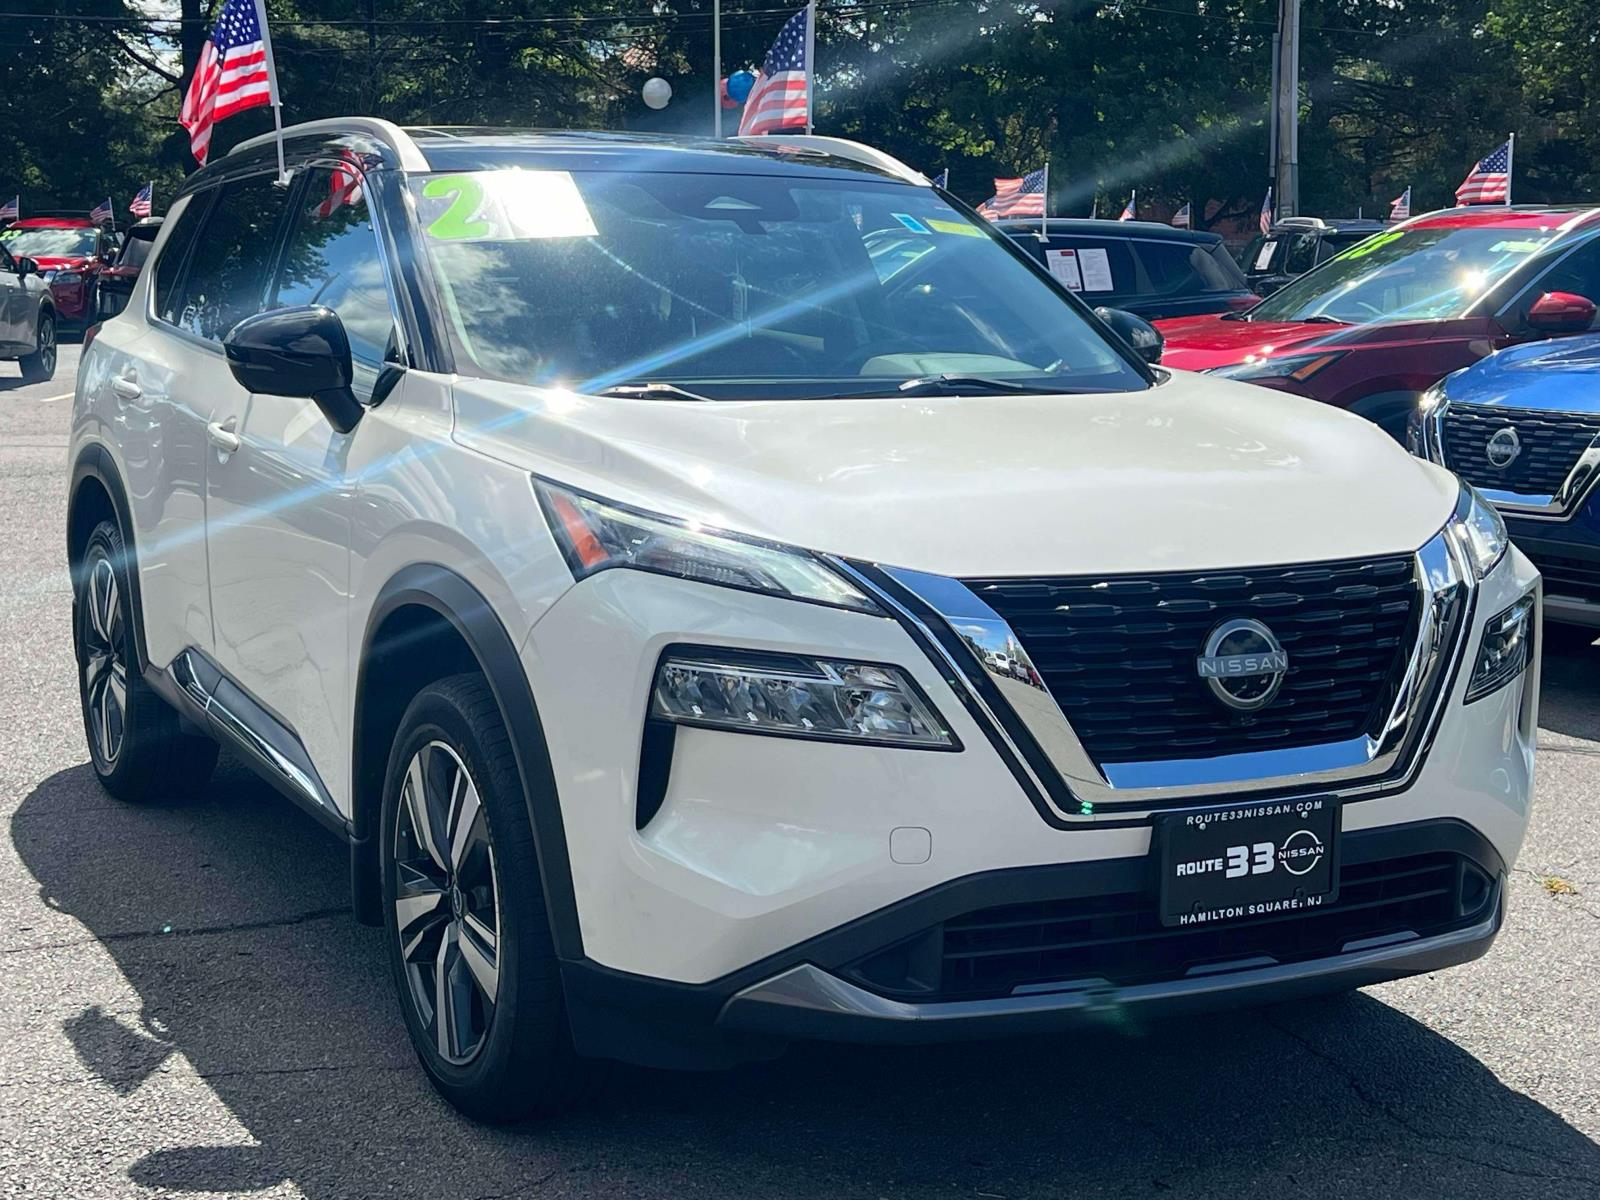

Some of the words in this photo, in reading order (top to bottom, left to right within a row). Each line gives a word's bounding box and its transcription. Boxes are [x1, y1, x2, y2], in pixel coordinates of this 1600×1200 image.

[1201, 655, 1286, 674] NISSAN
[1187, 801, 1323, 825] ROUTE33NISSAN.COM
[1176, 858, 1223, 877] ROUTE
[1226, 842, 1275, 879] 33
[1278, 846, 1325, 859] NISSAN
[1180, 906, 1243, 925] HAMILTON
[1248, 899, 1303, 915] SQUARE,
[1307, 895, 1323, 906] NJ
